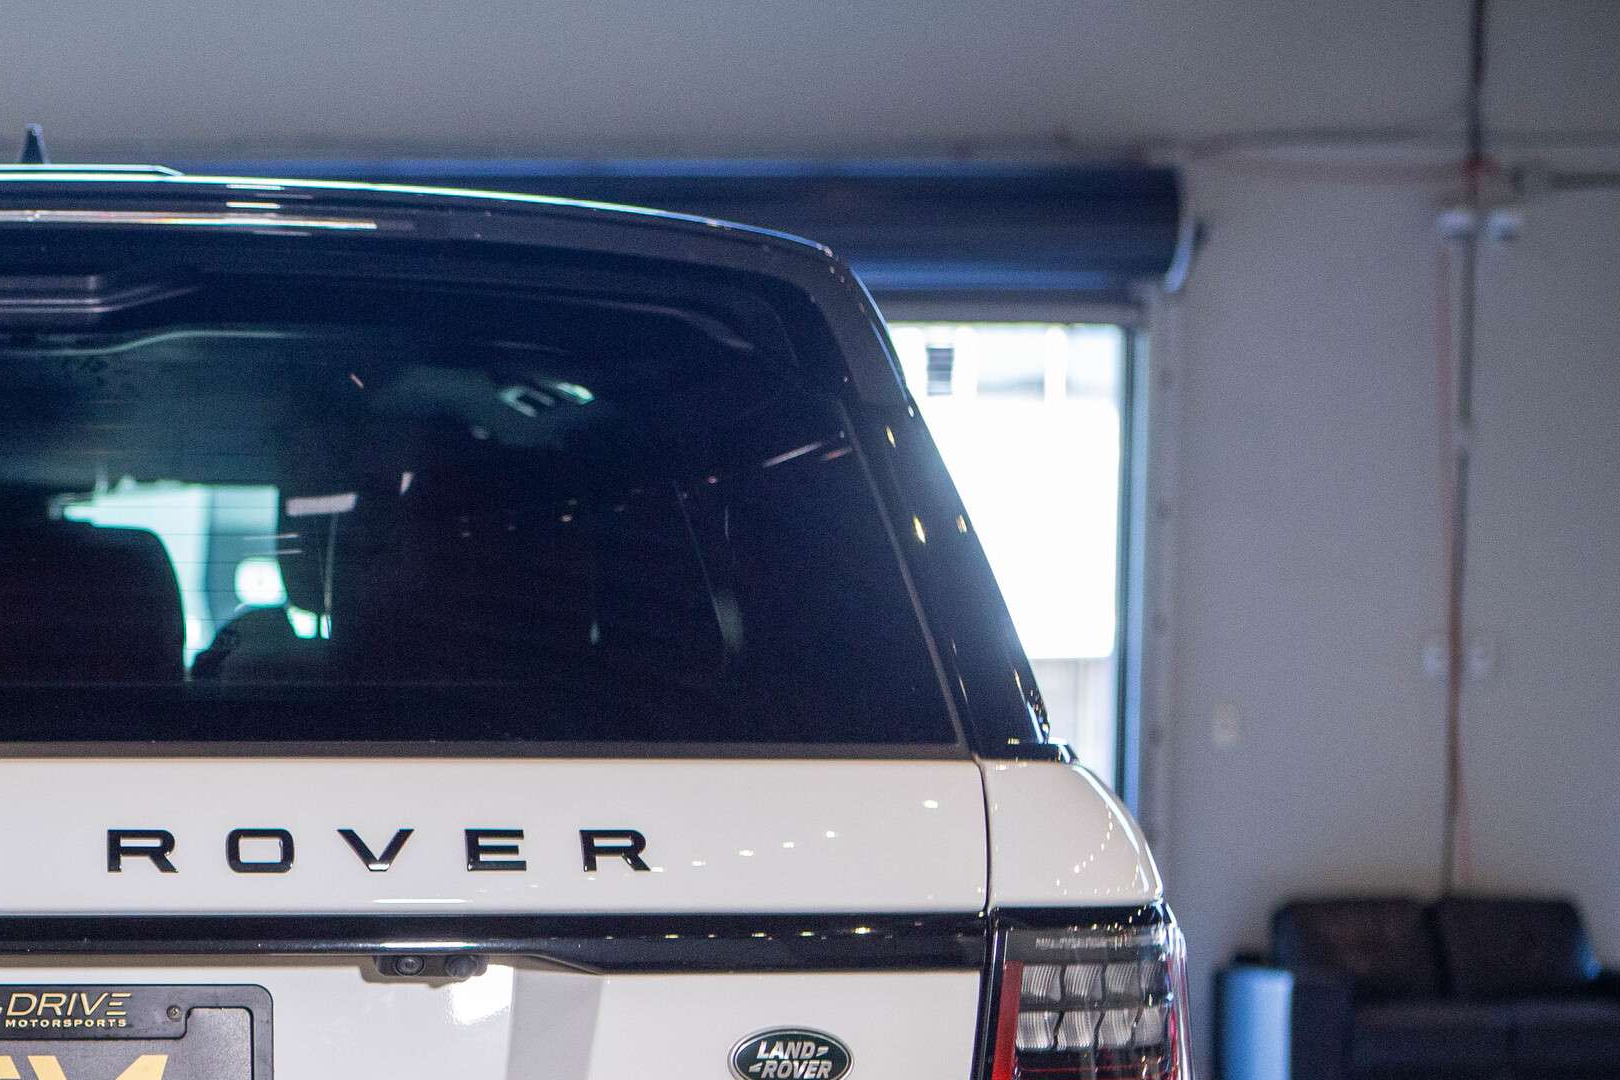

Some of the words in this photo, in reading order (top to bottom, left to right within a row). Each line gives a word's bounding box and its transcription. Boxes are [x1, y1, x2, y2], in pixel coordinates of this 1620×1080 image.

[106, 827, 652, 874] ROVER
[6, 992, 132, 1016] DRIVE
[5, 1018, 127, 1028] MOTORSPORTS
[760, 1060, 833, 1080] ROVER
